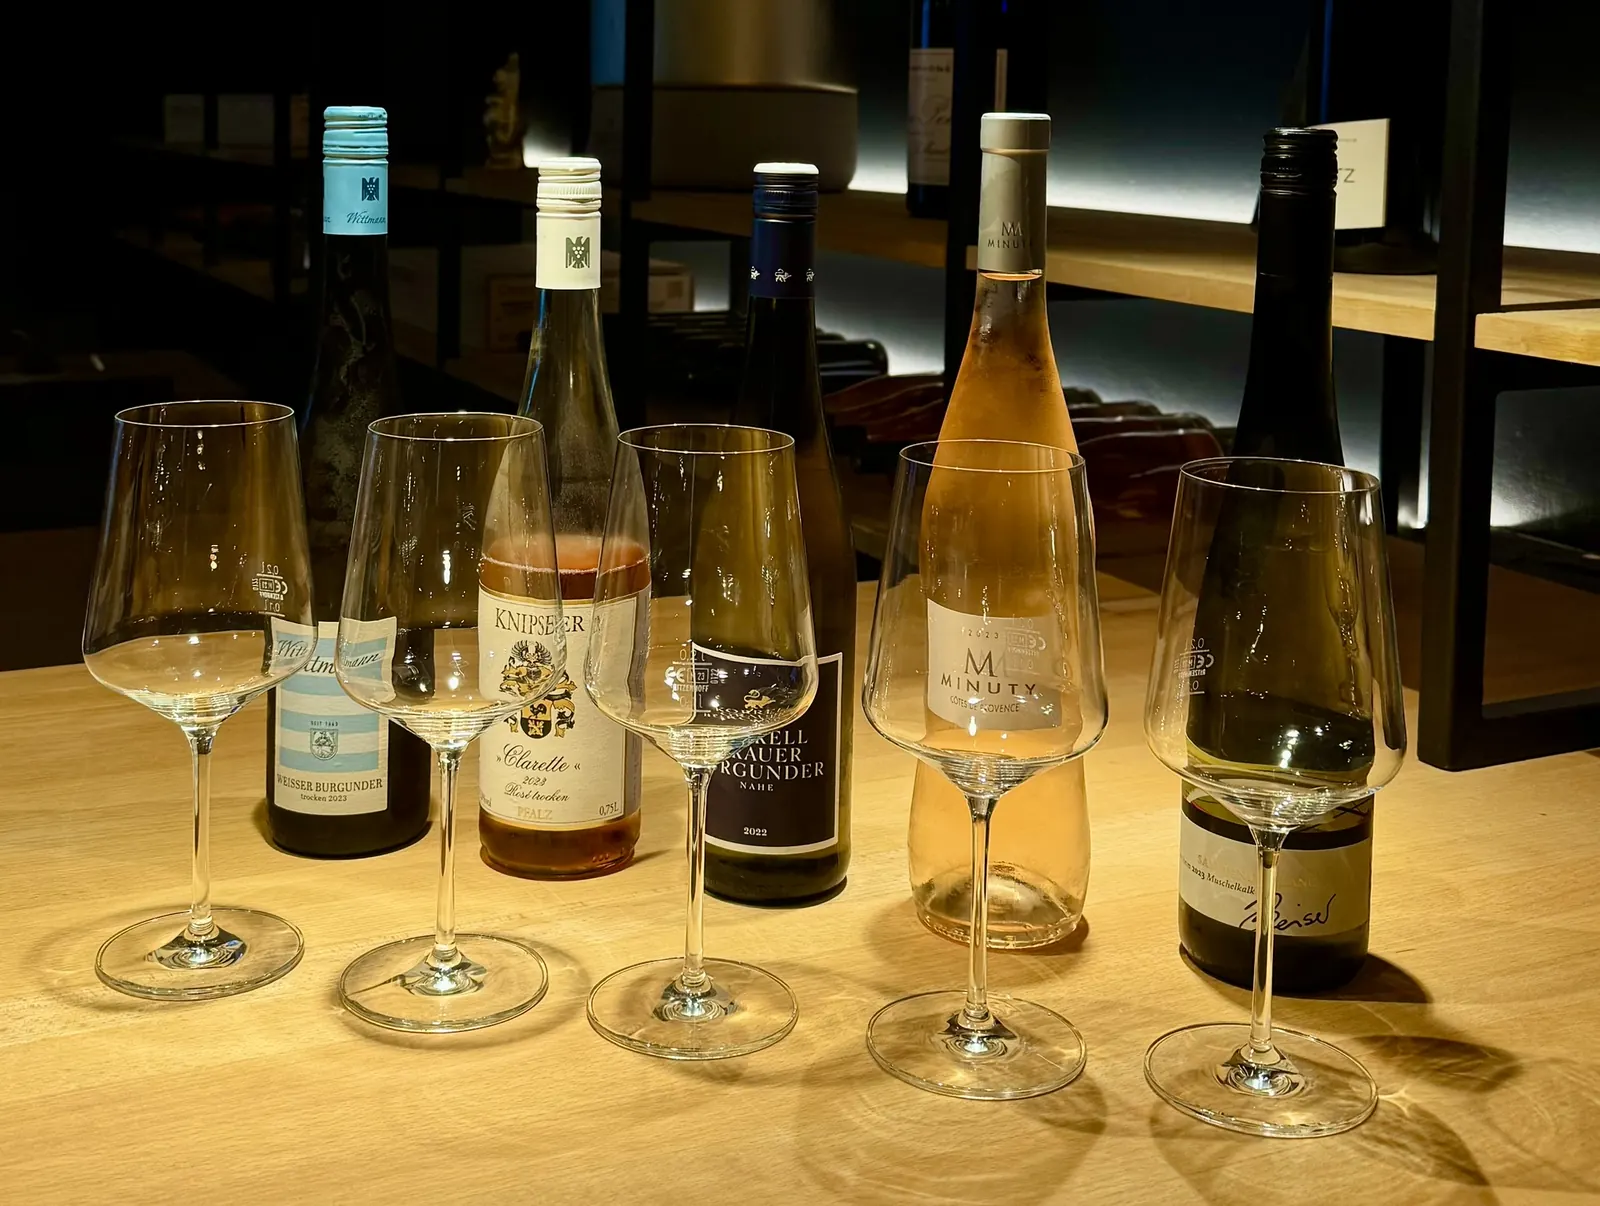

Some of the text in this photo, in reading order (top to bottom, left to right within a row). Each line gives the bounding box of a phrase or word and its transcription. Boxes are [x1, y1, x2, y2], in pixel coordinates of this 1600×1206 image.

[940, 672, 1036, 696] MINUTY
[720, 760, 825, 781] RGUNDER
[277, 773, 384, 793] WEISSER BURGUNDER
[522, 775, 548, 787] 2023
[739, 781, 774, 792] NAHE
[300, 793, 327, 802] trocken
[531, 789, 570, 802] trocken
[517, 805, 553, 820] PFALZ
[743, 826, 768, 837] 2022
[1191, 865, 1205, 880] 2023
[1206, 872, 1256, 895] Muschelkalk
